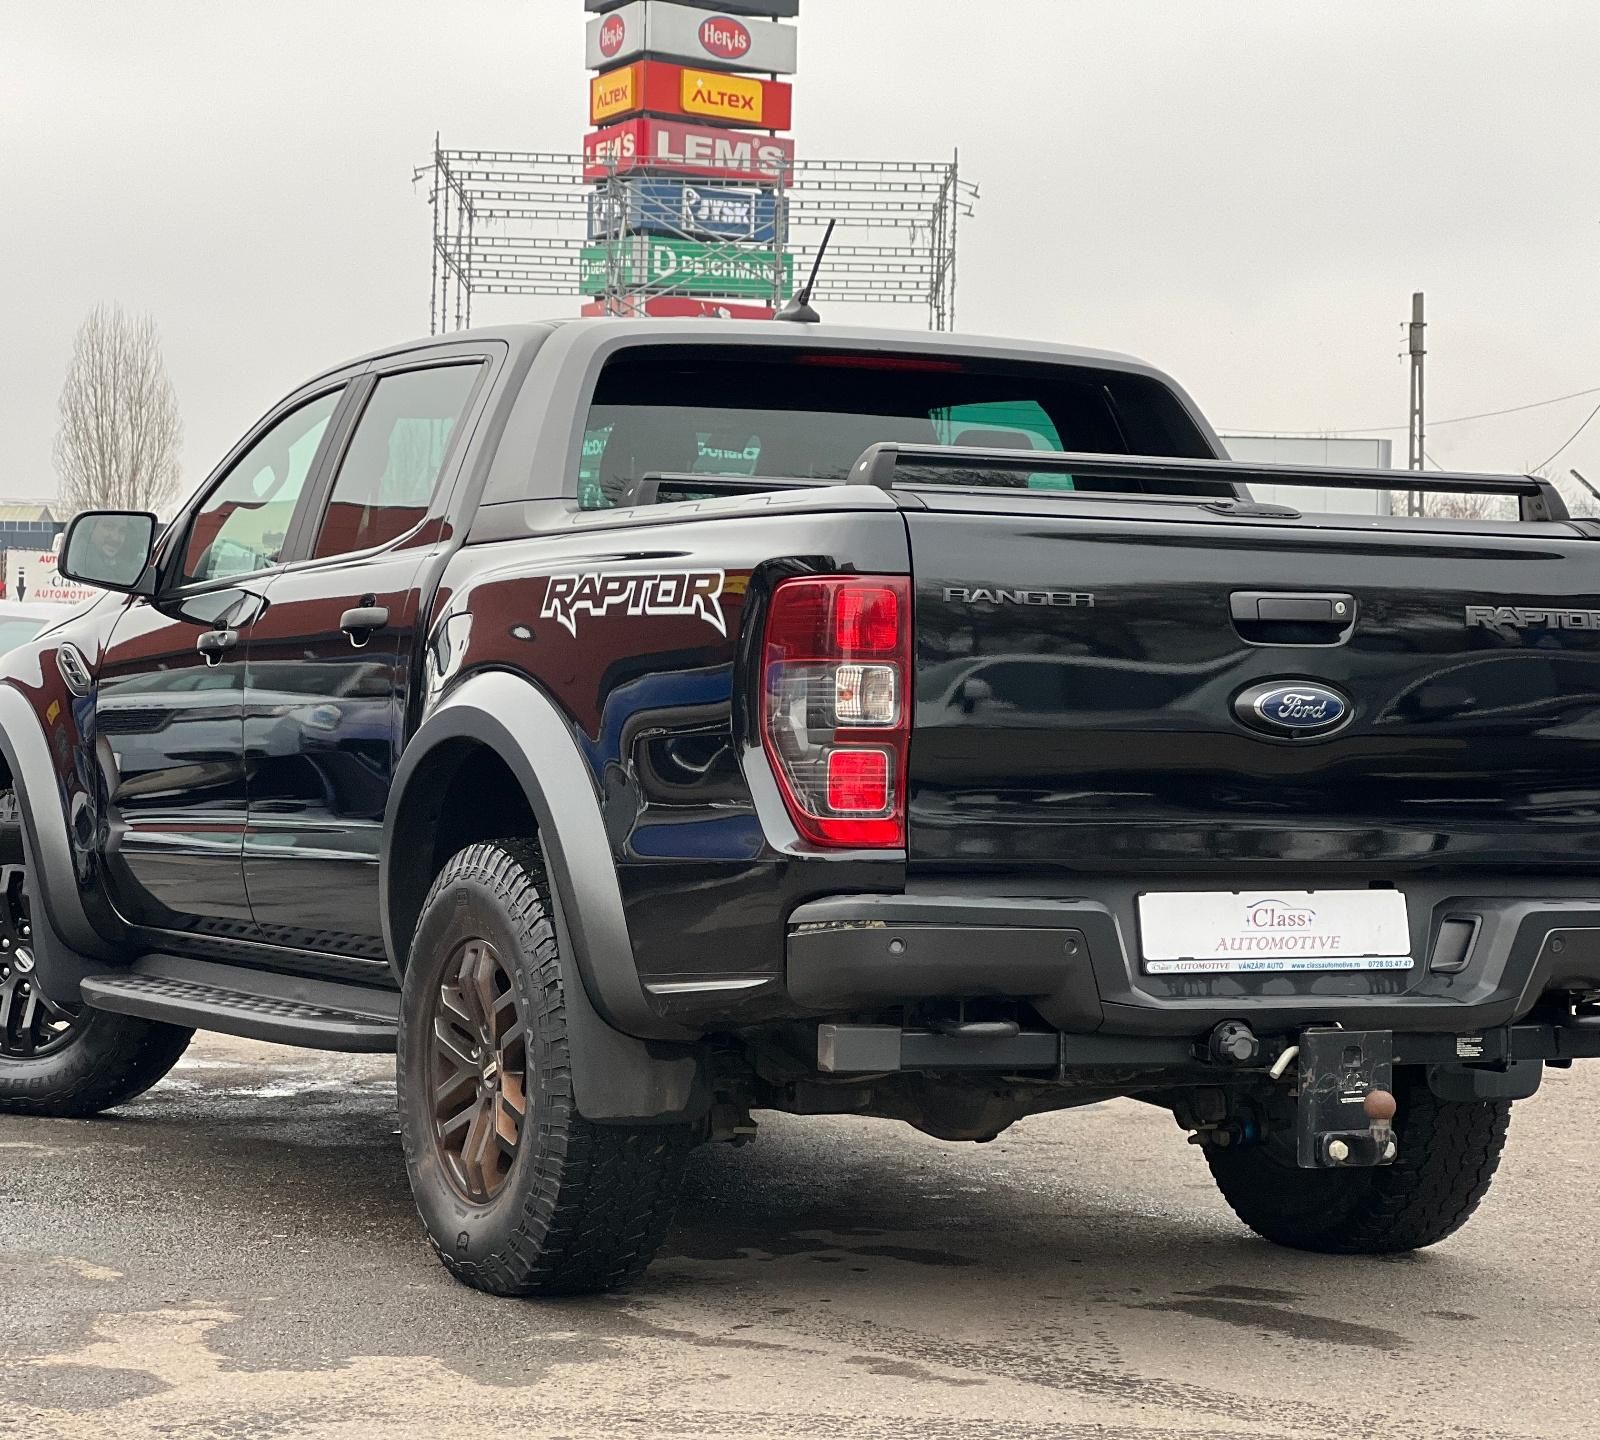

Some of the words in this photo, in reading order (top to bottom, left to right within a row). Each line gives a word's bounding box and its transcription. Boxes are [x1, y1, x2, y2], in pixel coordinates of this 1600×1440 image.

[704, 23, 747, 50] Hervis
[39, 555, 58, 563] AUT
[540, 567, 727, 639] RAPTOR
[943, 587, 1095, 608] RANGER
[1278, 693, 1328, 718] Ford
[1252, 908, 1306, 928] Class
[1215, 935, 1341, 951] AUTOMOTIVE
[1174, 962, 1231, 970] AUTOMOTIVE
